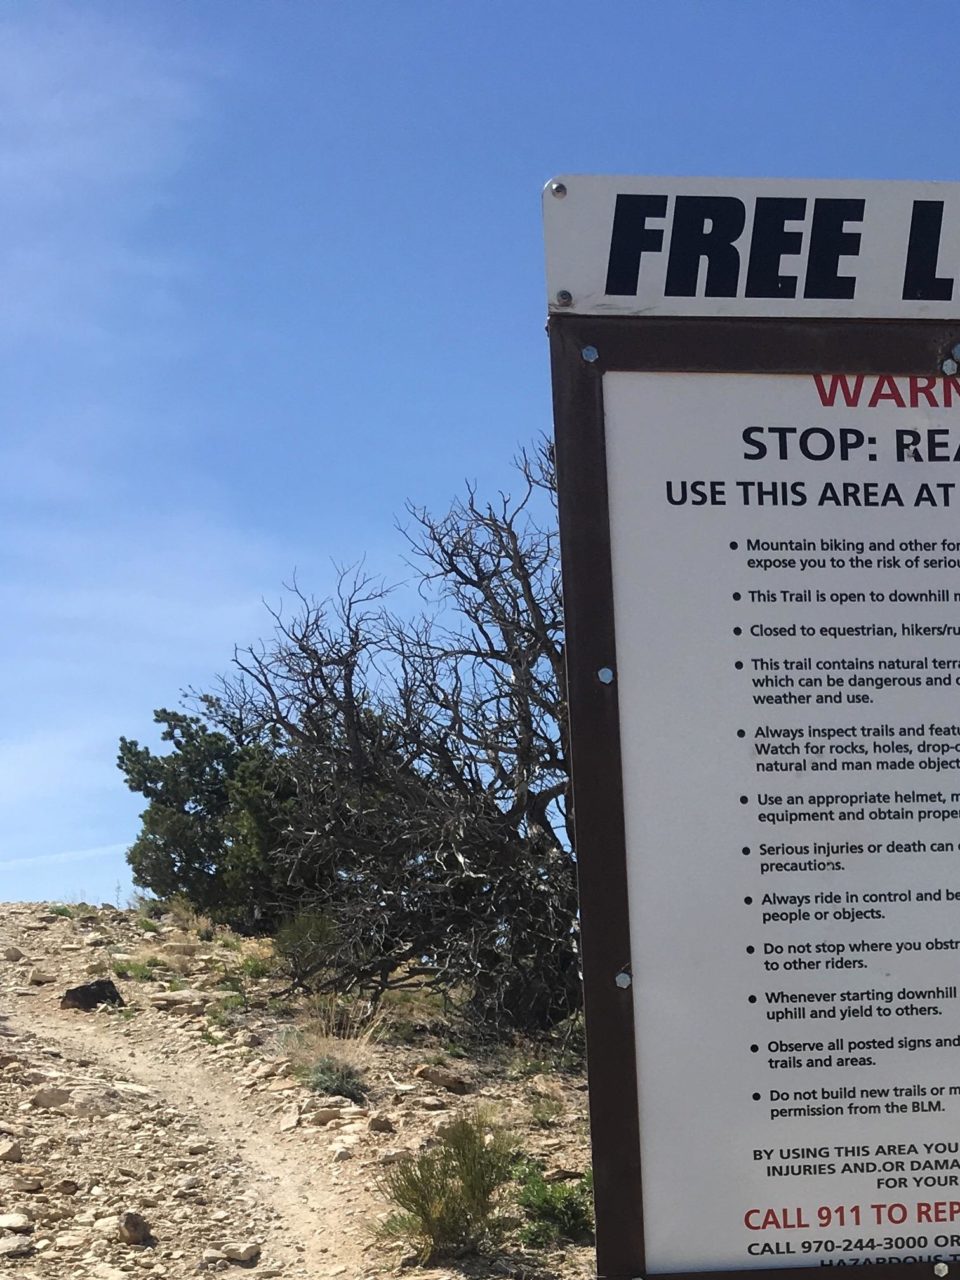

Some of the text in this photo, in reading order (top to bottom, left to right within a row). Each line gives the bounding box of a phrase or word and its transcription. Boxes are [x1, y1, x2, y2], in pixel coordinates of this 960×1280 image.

[603, 193, 867, 300] FREE
[741, 425, 878, 462] STOP:
[665, 480, 727, 507] USE
[735, 480, 808, 507] THIS
[817, 481, 905, 508] AREA
[913, 482, 956, 508] AT
[747, 589, 778, 603] This
[779, 589, 812, 603] Trail
[815, 589, 827, 603] is
[829, 592, 866, 606] open
[868, 590, 886, 603] to
[888, 588, 950, 603] downhill
[749, 623, 797, 638] Closed
[799, 624, 816, 637] to
[819, 623, 898, 640] equestrian,
[754, 741, 801, 756] Watch
[803, 741, 826, 755] for
[829, 740, 869, 756] rocks,
[872, 740, 914, 756] holes,
[760, 858, 846, 876] precautions.
[770, 1099, 946, 1121] permission from the BLM.
[876, 1176, 909, 1190] FOR
[911, 1174, 960, 1188] YOUR
[743, 1207, 811, 1231] CALL
[817, 1205, 861, 1228] 911
[870, 1202, 908, 1226] TO
[747, 1241, 797, 1256] CALL
[800, 1235, 929, 1254] 970-244-3000
